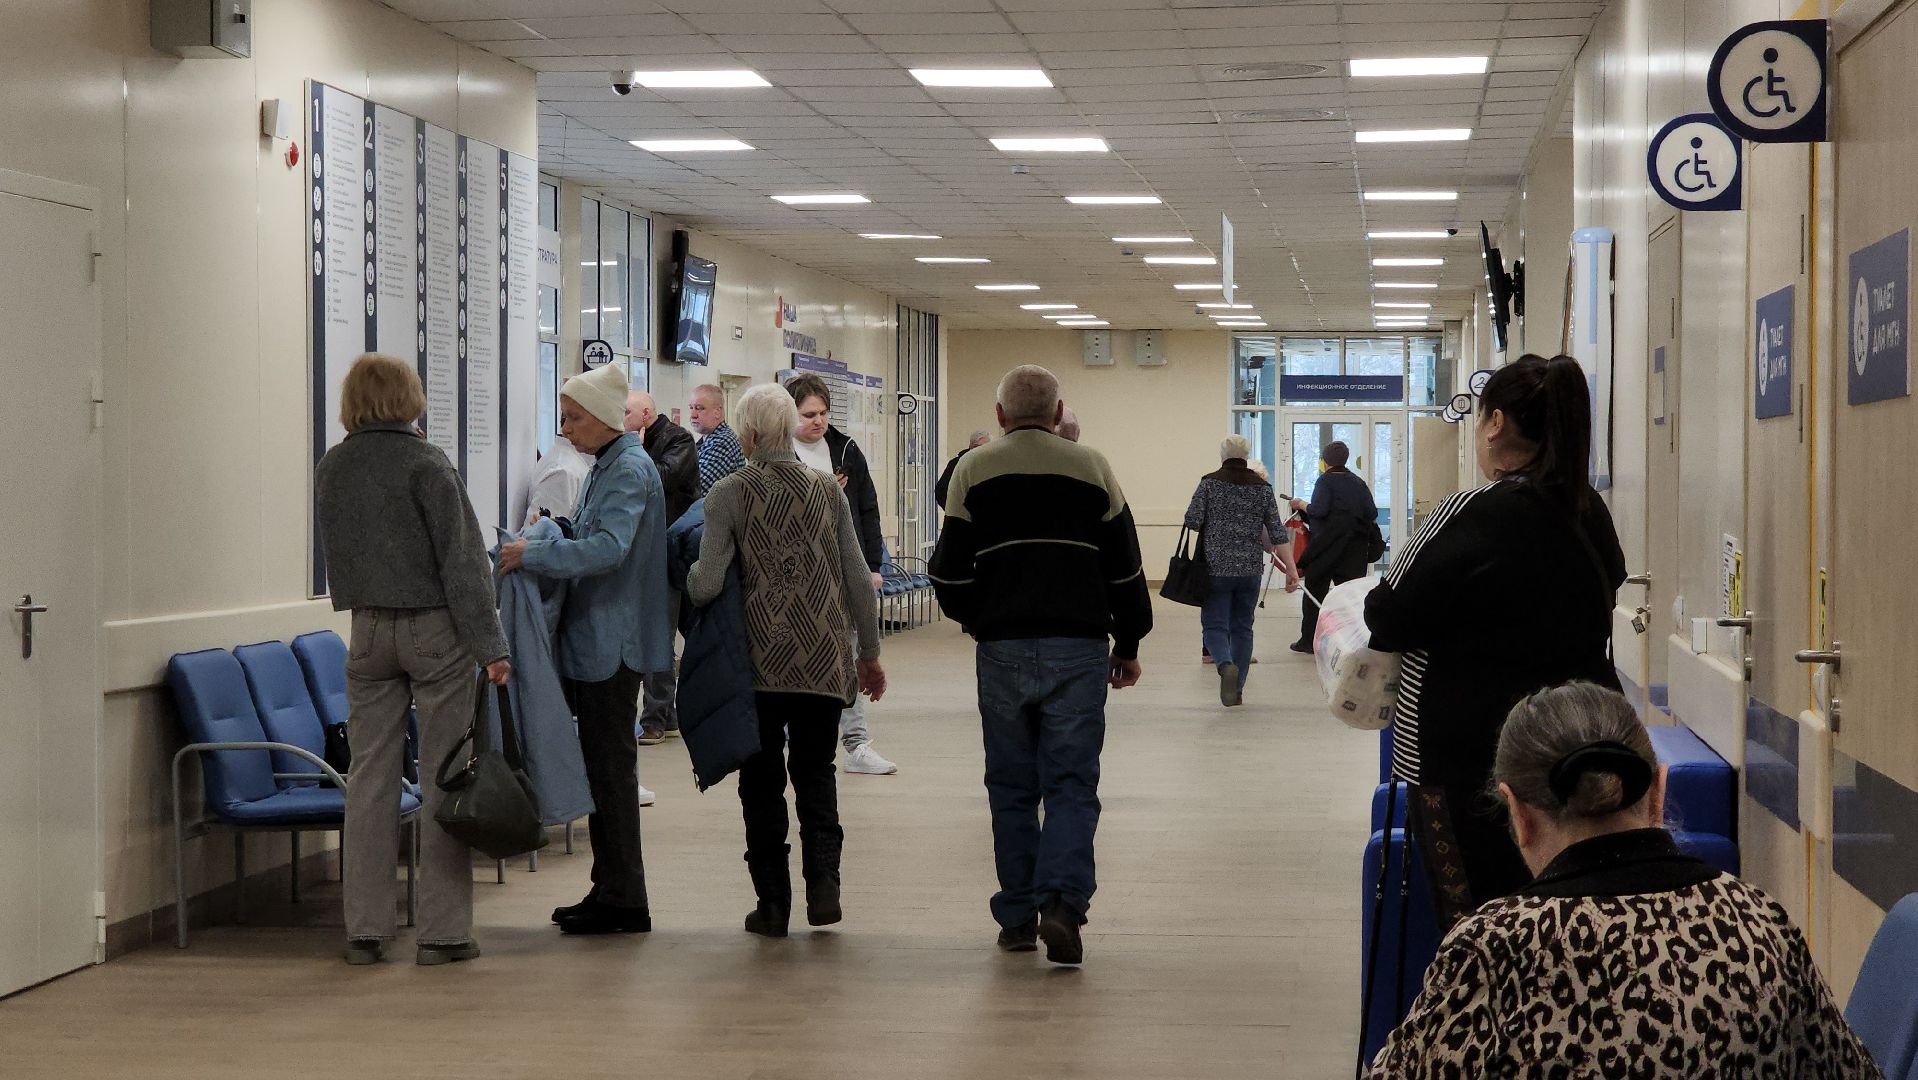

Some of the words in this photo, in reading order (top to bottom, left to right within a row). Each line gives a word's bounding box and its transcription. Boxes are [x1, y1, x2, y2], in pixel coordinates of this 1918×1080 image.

[313, 98, 319, 132] 1
[364, 116, 373, 150] 2
[417, 133, 424, 165] 3
[459, 150, 467, 179] 4
[500, 162, 507, 191] 5
[1873, 281, 1895, 313] ТУАЛЕТ
